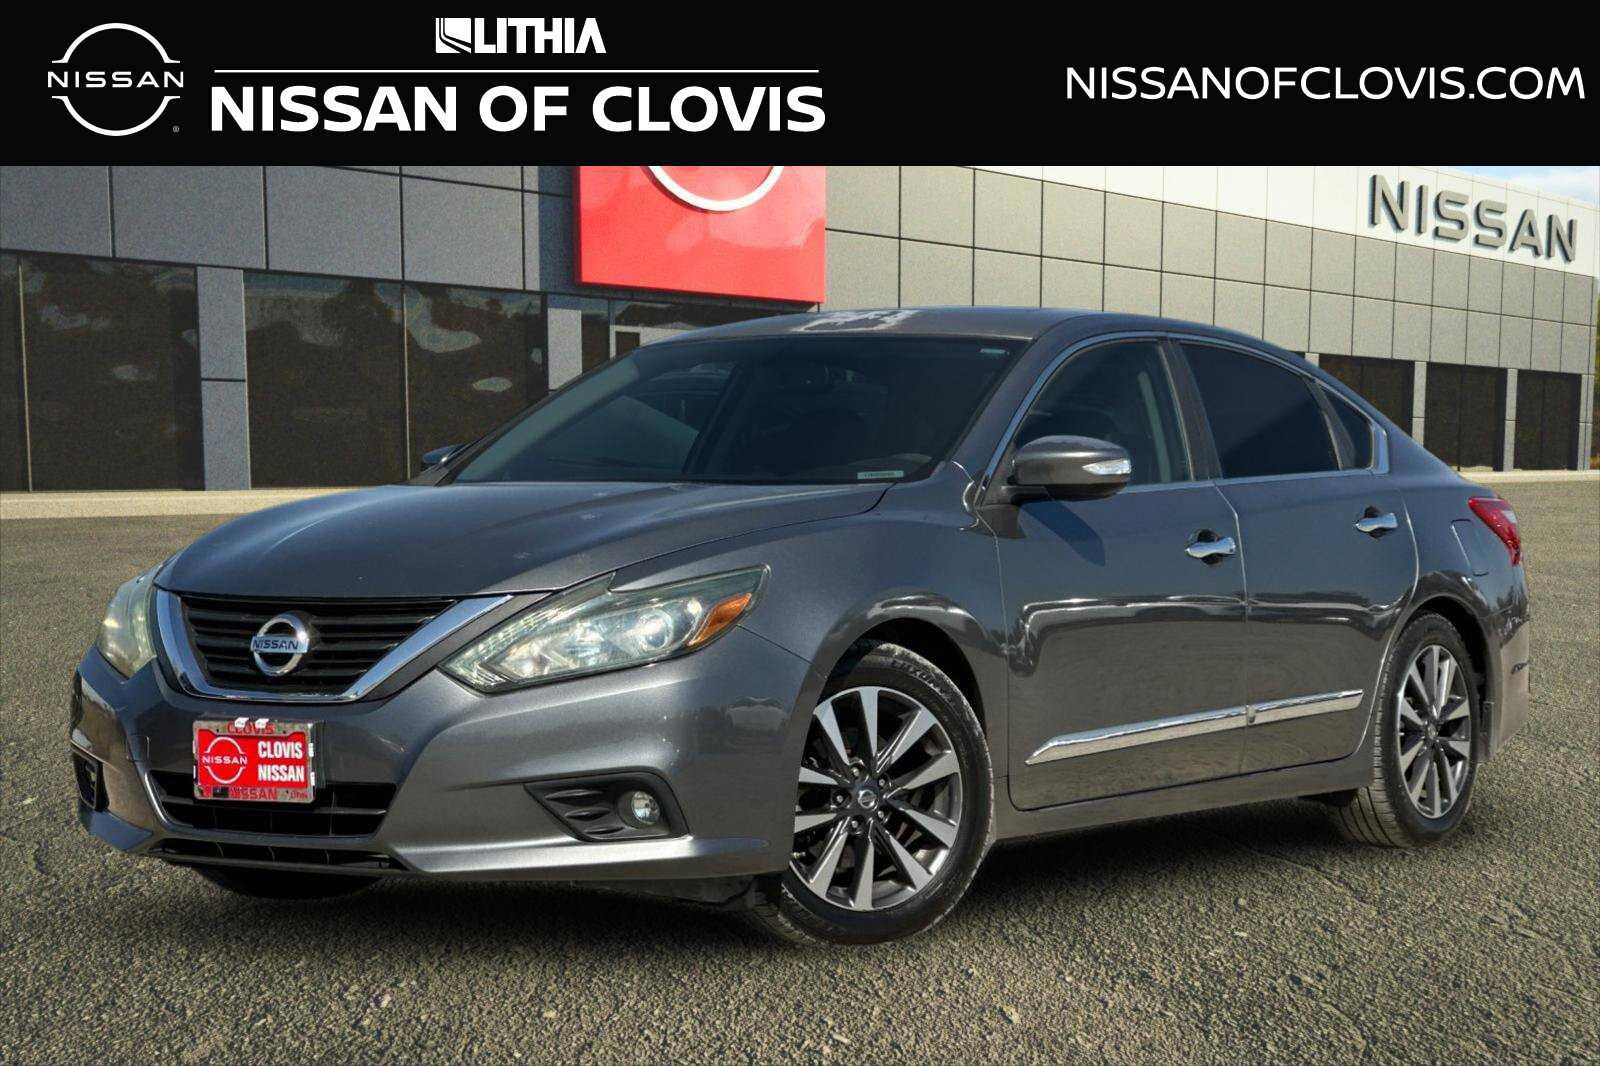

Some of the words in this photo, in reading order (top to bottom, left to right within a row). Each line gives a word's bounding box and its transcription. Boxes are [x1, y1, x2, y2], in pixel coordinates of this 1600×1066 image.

[1369, 174, 1578, 262] NISSAN
[253, 639, 299, 650] NISSAN
[257, 741, 304, 759] CLOVIS
[202, 755, 248, 765] NISSAN
[258, 765, 305, 782] NISSAN
